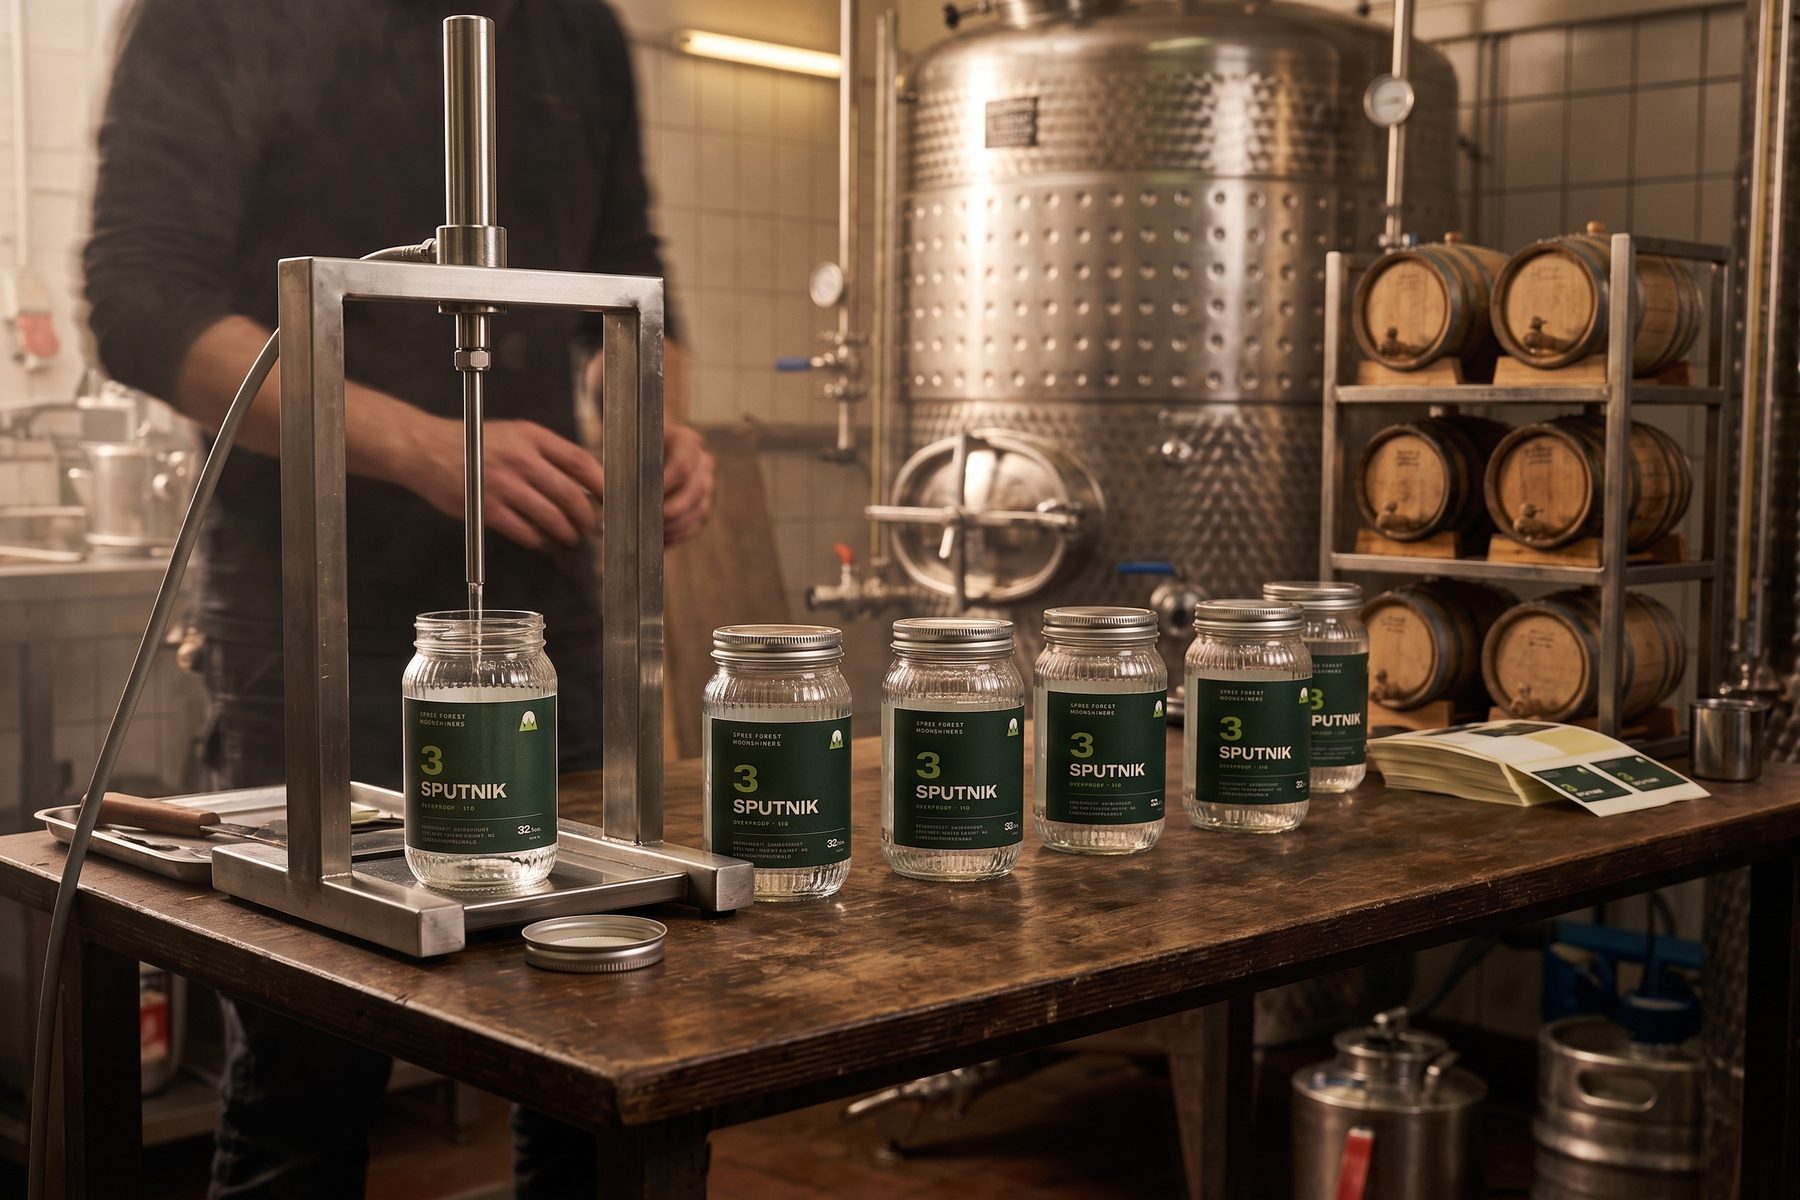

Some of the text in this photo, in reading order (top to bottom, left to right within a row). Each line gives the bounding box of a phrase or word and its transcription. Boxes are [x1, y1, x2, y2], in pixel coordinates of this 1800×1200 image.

[1312, 688, 1324, 710] 3
[440, 712, 466, 720] FOREST
[1312, 712, 1360, 727] PUTNIK
[1220, 716, 1242, 741] 3
[1070, 732, 1094, 758] 3
[1219, 746, 1292, 760] SPUTNIK
[421, 745, 442, 776] 3
[916, 752, 940, 779] 3
[734, 764, 758, 793] 3
[1070, 762, 1145, 778] SPUTNIK
[421, 781, 507, 799] SPUTNIK
[916, 784, 998, 800] SPUTNIK
[733, 799, 819, 815] SPUTNIK
